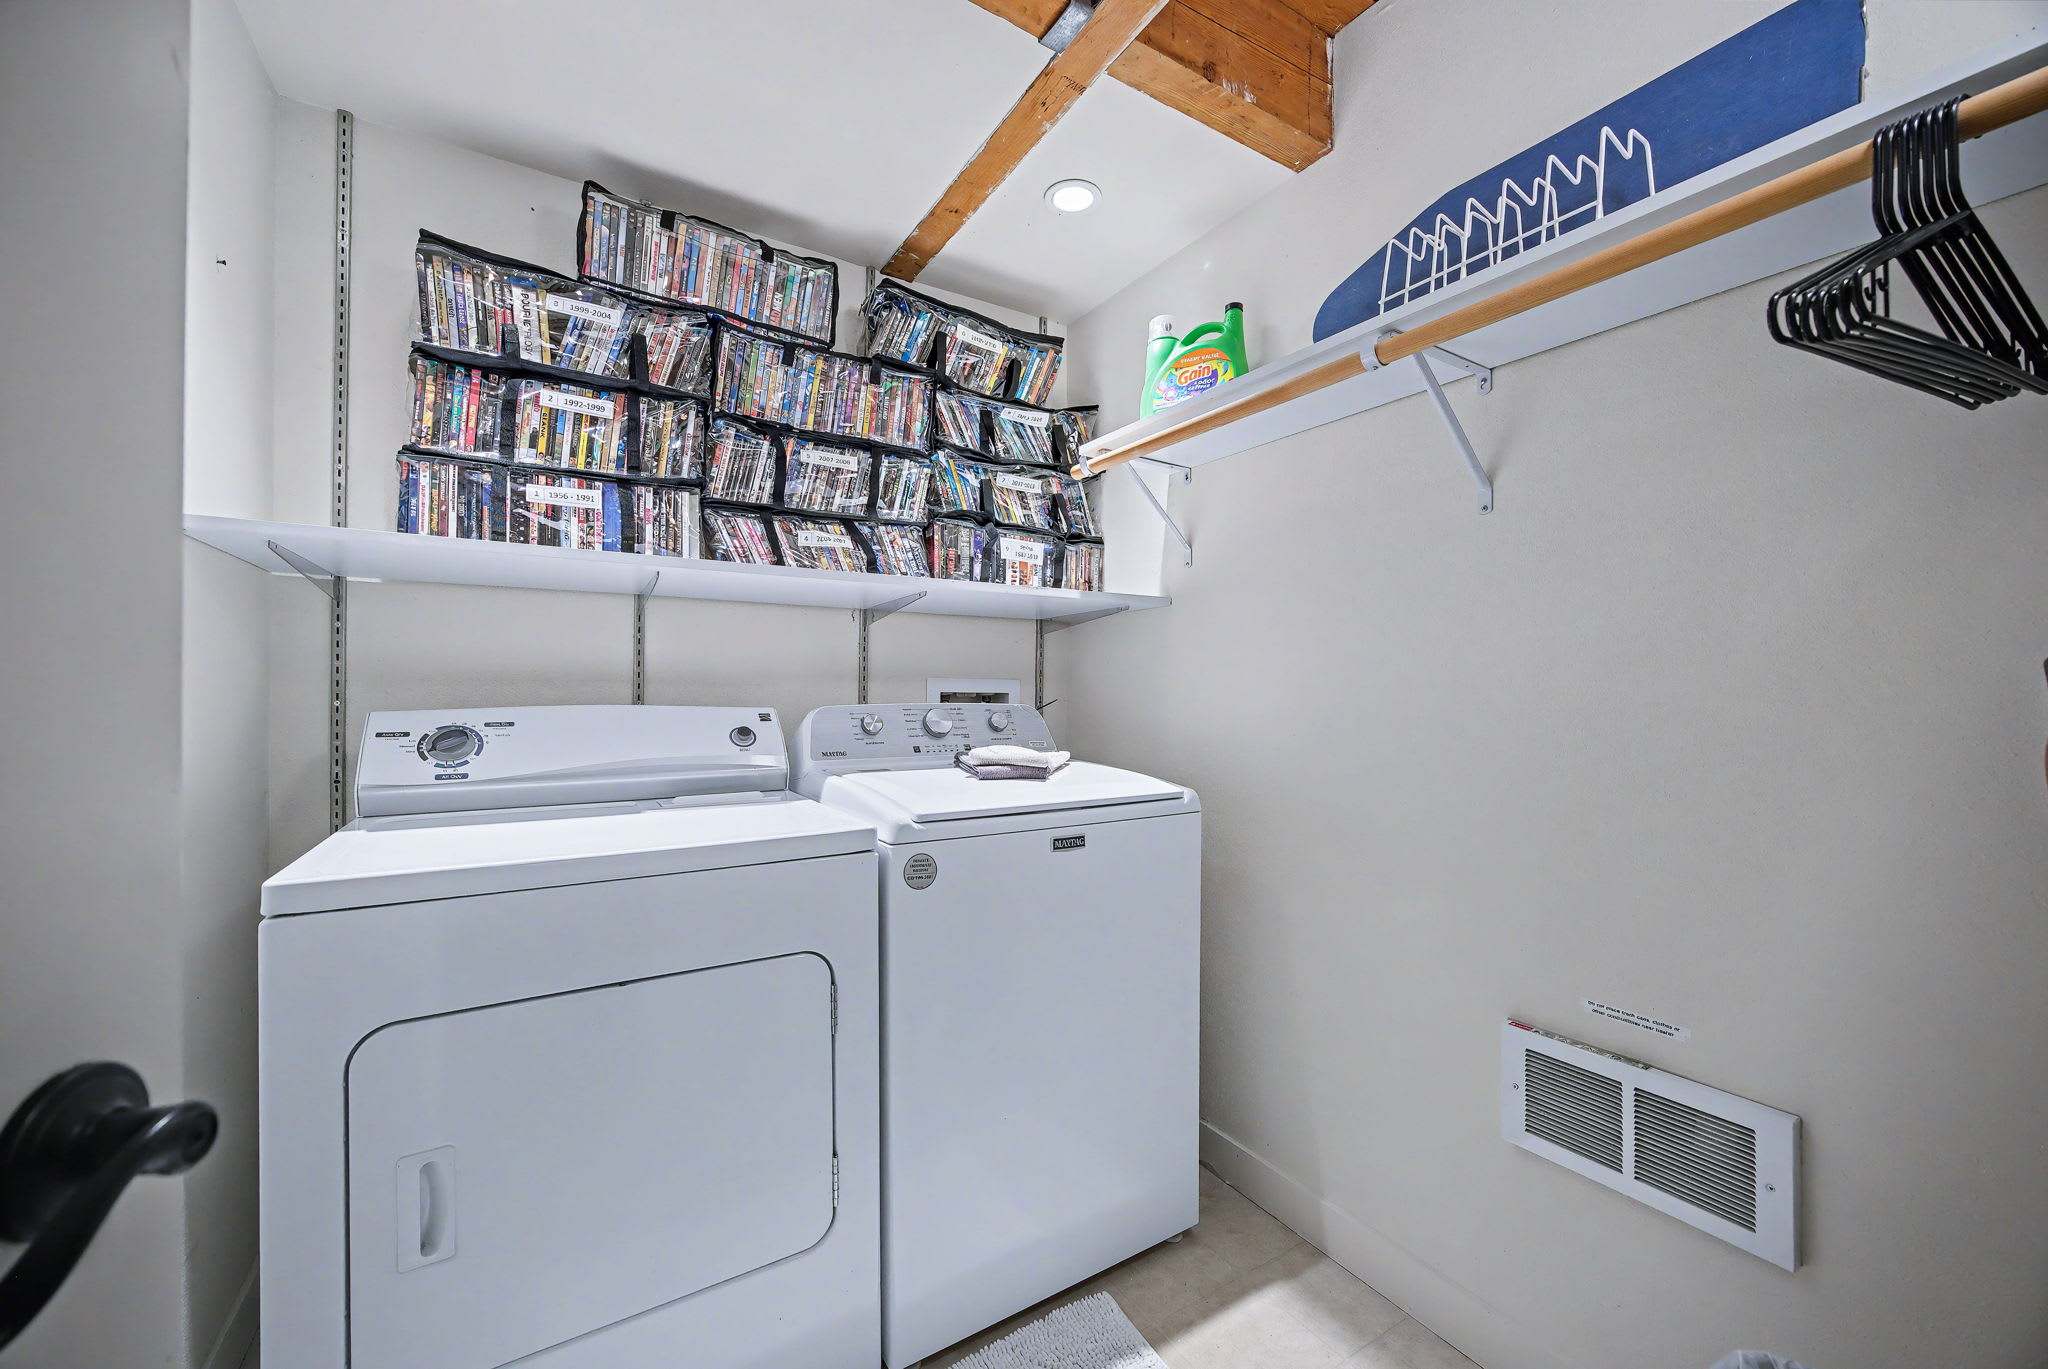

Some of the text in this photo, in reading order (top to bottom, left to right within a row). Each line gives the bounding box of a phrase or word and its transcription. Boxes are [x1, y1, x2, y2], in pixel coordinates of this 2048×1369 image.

[569, 304, 612, 320] 1999-2004
[1177, 365, 1212, 386] Gain
[548, 394, 553, 403] 2
[564, 398, 606, 413] 1992-1999
[548, 491, 569, 500] 1956
[576, 494, 595, 503] 1991
[1054, 837, 1085, 849] MAYTAG
[1591, 1008, 1606, 1016] other
[1655, 1027, 1675, 1037] heater
[1605, 1005, 1621, 1014] place
[1621, 1010, 1635, 1018] trash
[1652, 1020, 1673, 1030] clothes
